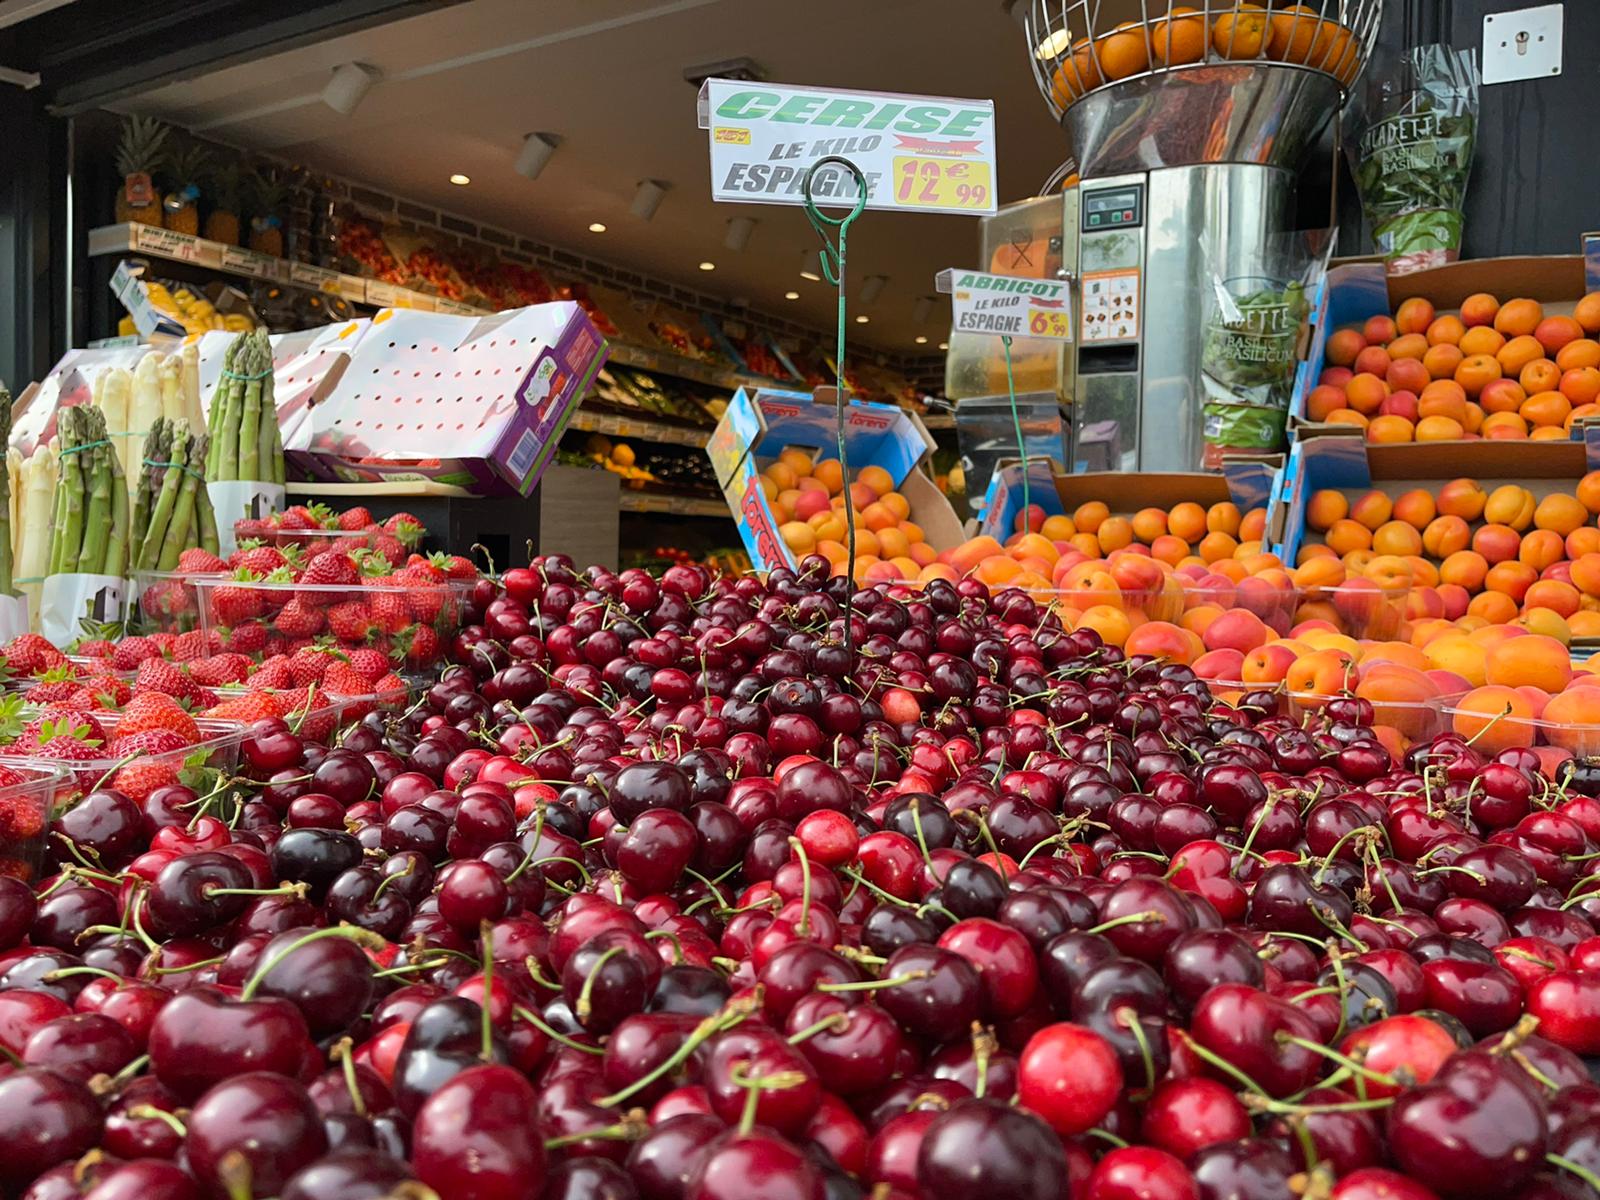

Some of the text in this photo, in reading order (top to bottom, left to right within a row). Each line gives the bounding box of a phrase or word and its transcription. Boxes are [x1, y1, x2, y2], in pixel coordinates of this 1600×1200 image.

[715, 91, 992, 137] CERISE
[768, 135, 882, 160] LE KILO
[722, 163, 883, 199] ESPAGNE
[956, 274, 1064, 297] ABRICOT
[975, 296, 1020, 310] LE KILO
[959, 312, 1022, 333] ESPAGNE
[1228, 336, 1277, 351] BASILIC
